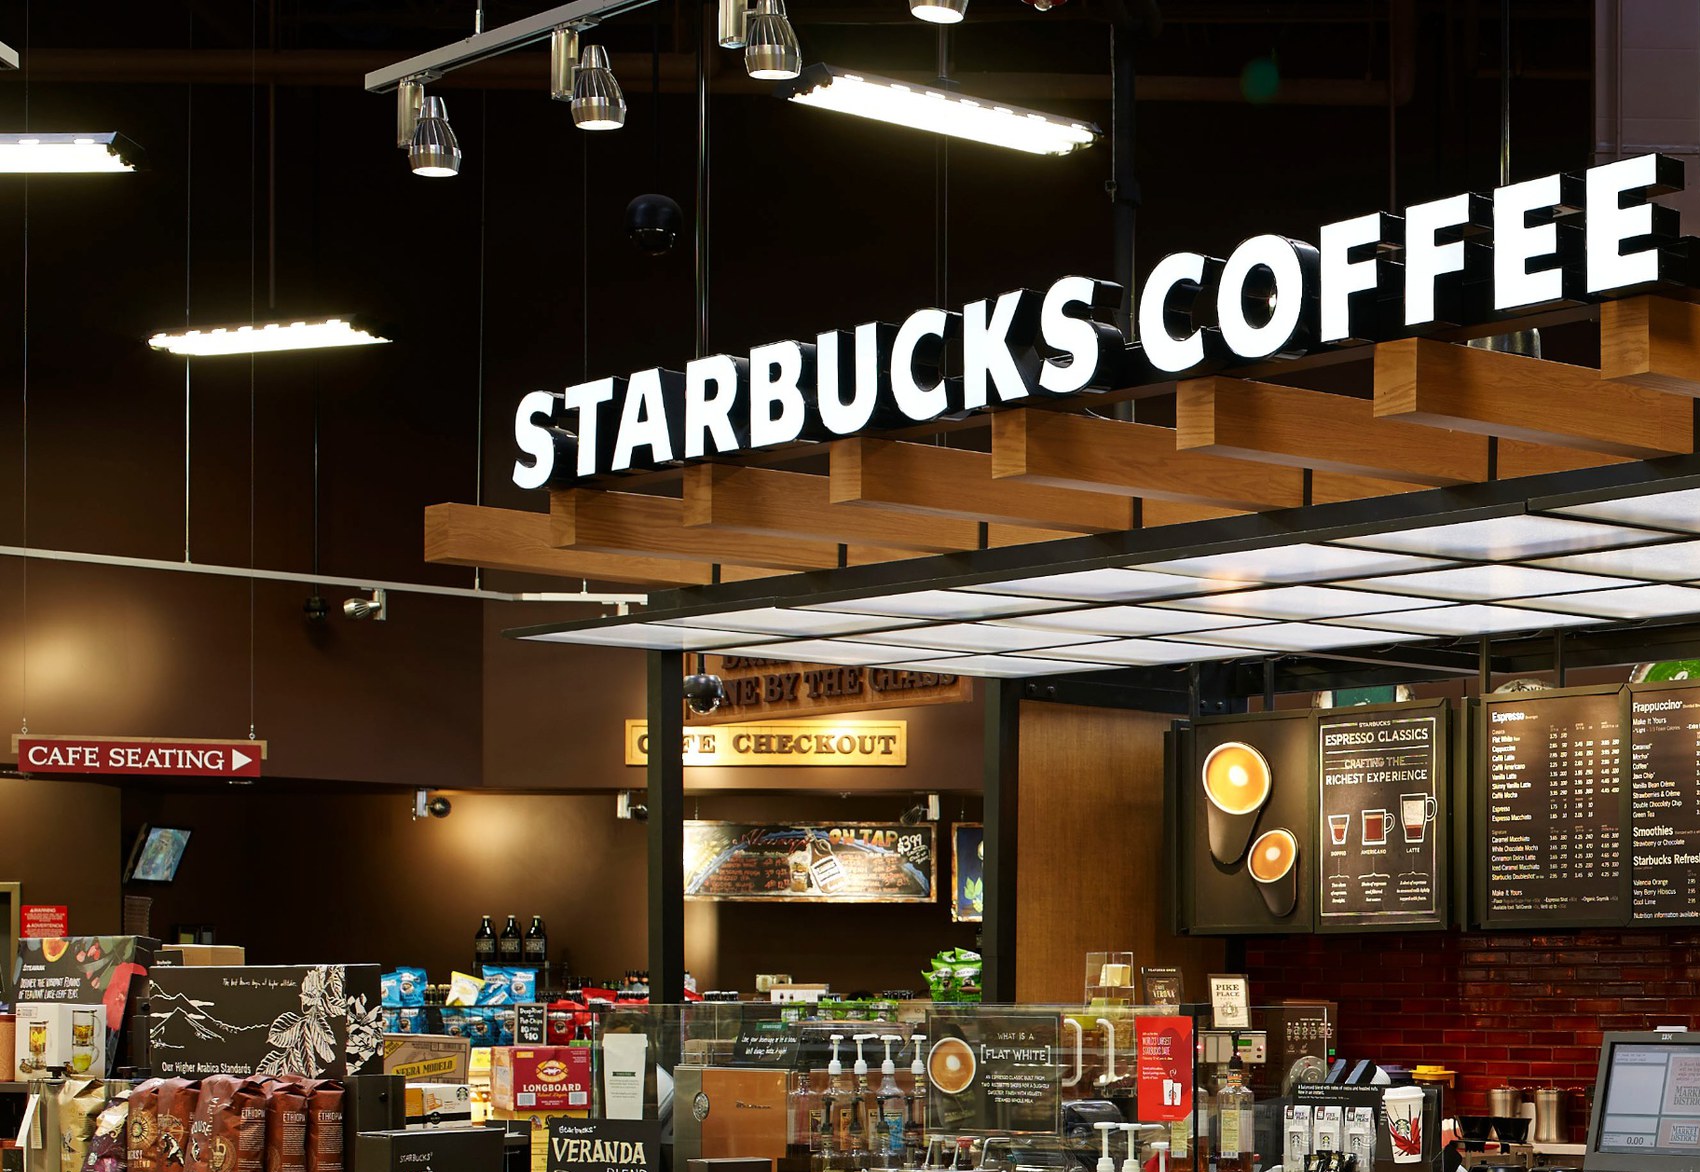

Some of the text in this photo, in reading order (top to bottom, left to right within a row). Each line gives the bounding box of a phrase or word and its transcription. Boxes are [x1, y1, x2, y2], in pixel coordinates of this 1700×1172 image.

[512, 153, 1660, 491] STARBUCKS COFFEE
[763, 672, 799, 701] BY
[803, 666, 864, 698] THE
[1492, 712, 1525, 723] Espresso
[1325, 728, 1429, 746] ESPRESSO CLASSICS
[637, 733, 897, 755] CFE CHECKOUT
[28, 746, 225, 771] CAFE SEATING
[1344, 756, 1405, 769] CRAFTING THE
[1325, 769, 1428, 785] RICHEST EXPERIENCE
[1633, 825, 1674, 837] Smoothies
[829, 829, 855, 845] ON
[858, 829, 898, 847] TAP
[1633, 854, 1672, 866] Starbucks
[997, 1032, 1015, 1040] WHAT
[1018, 1032, 1026, 1040] IS
[161, 1061, 251, 1075] Our Higher Arabica Standards
[423, 1060, 453, 1073] MODELO
[523, 1083, 581, 1092] LONGBOARD
[1626, 1136, 1644, 1145] 0.00
[551, 1137, 647, 1165] VERANDA
[400, 1153, 431, 1163] STARBUCKS
